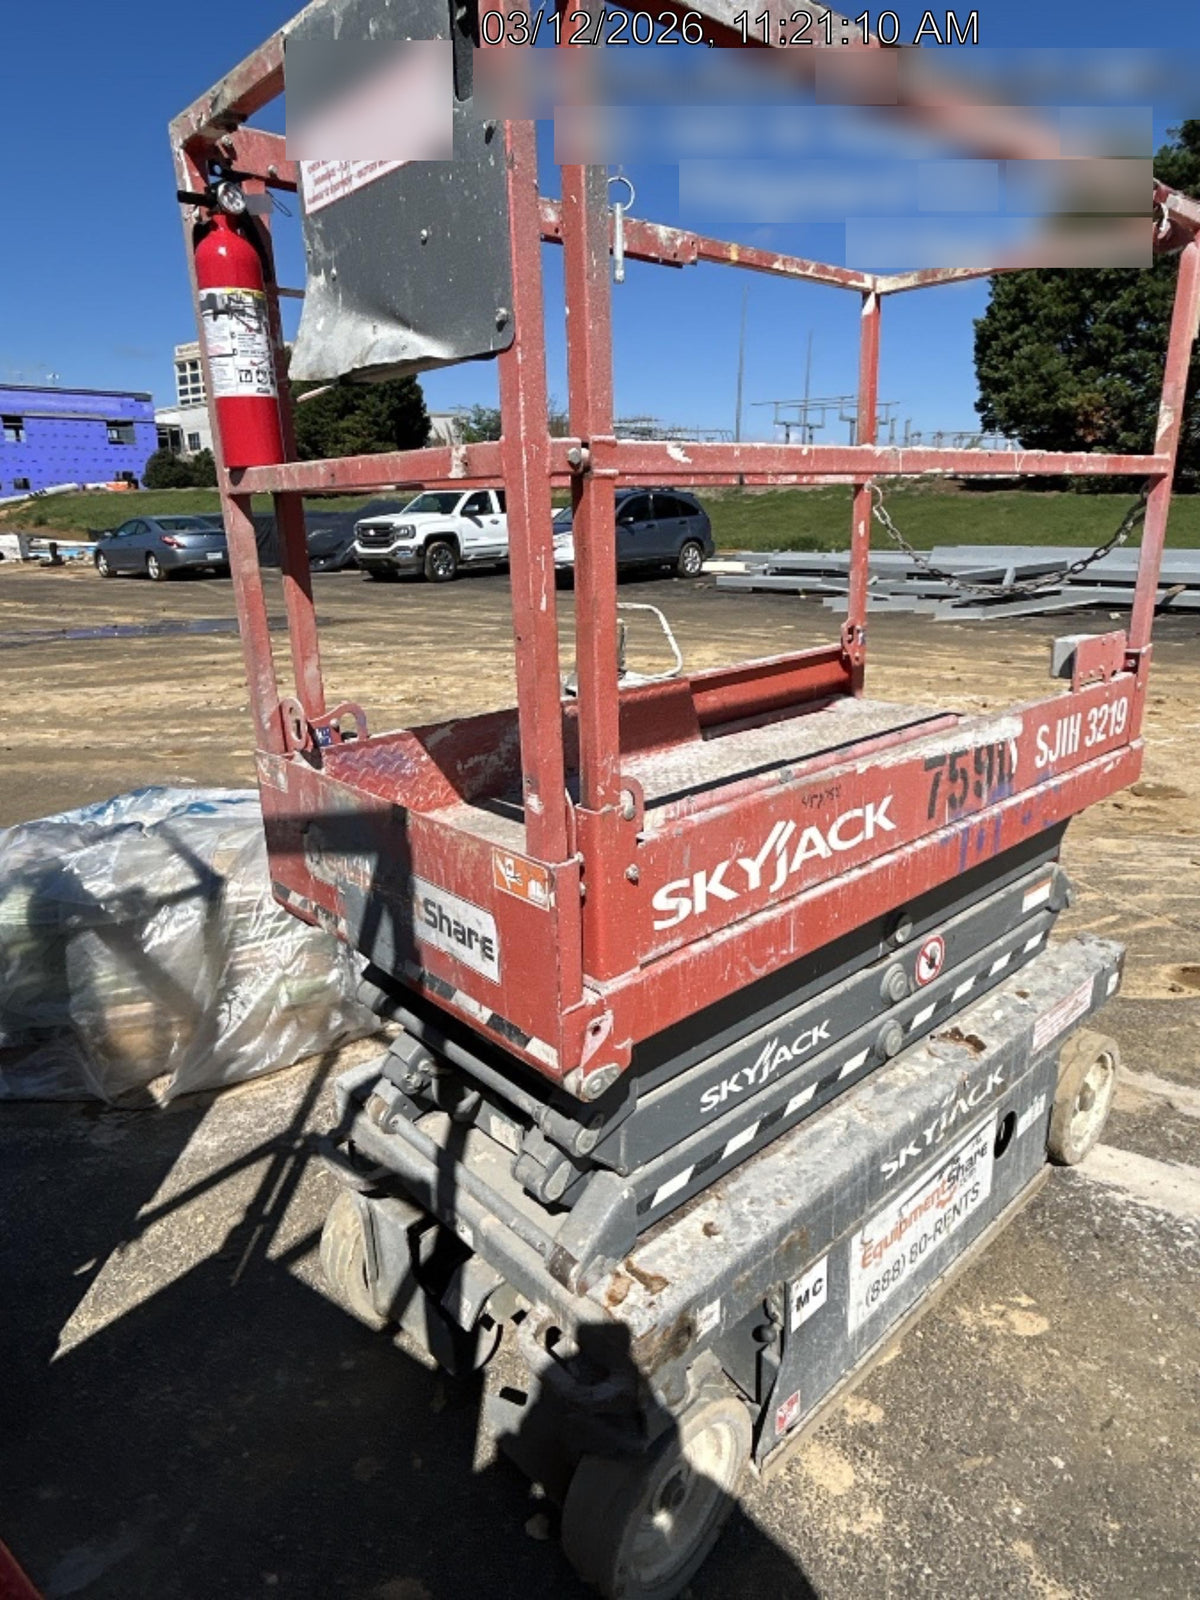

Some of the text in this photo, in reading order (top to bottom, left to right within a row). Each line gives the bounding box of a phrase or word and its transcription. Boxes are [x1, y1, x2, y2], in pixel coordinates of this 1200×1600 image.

[1084, 696, 1128, 747] 3219
[652, 795, 897, 931] SKYJACK
[700, 1018, 831, 1113] SKYJACK
[865, 1181, 980, 1308] (888) 80-RENTS
